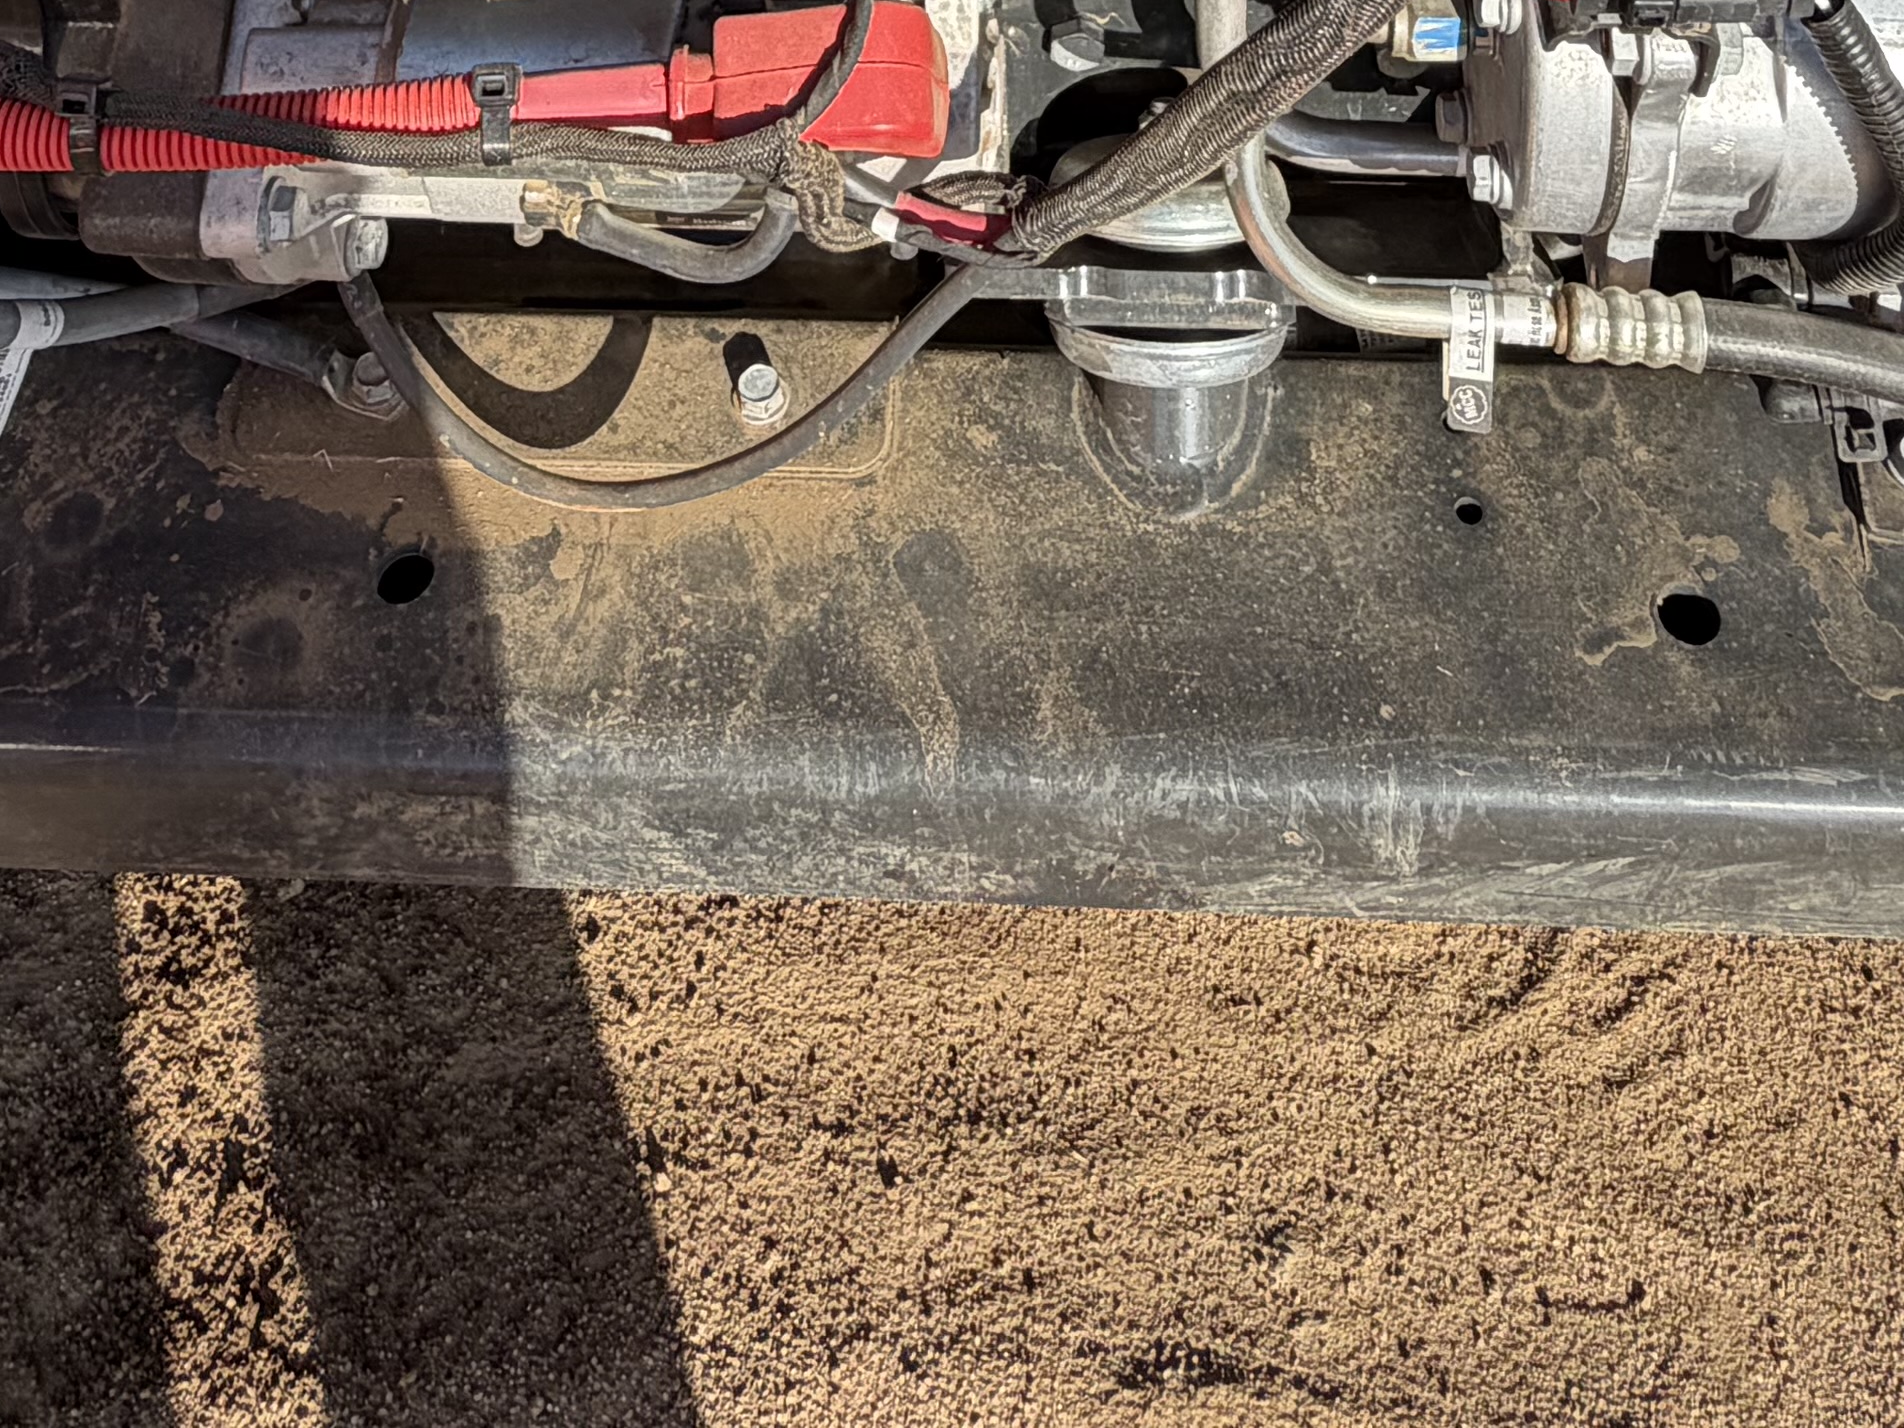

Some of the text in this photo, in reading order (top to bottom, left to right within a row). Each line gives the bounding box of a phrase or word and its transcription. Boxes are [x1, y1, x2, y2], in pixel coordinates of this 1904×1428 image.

[1465, 290, 1483, 372] LEAK TES
[1458, 388, 1479, 419] MCC
